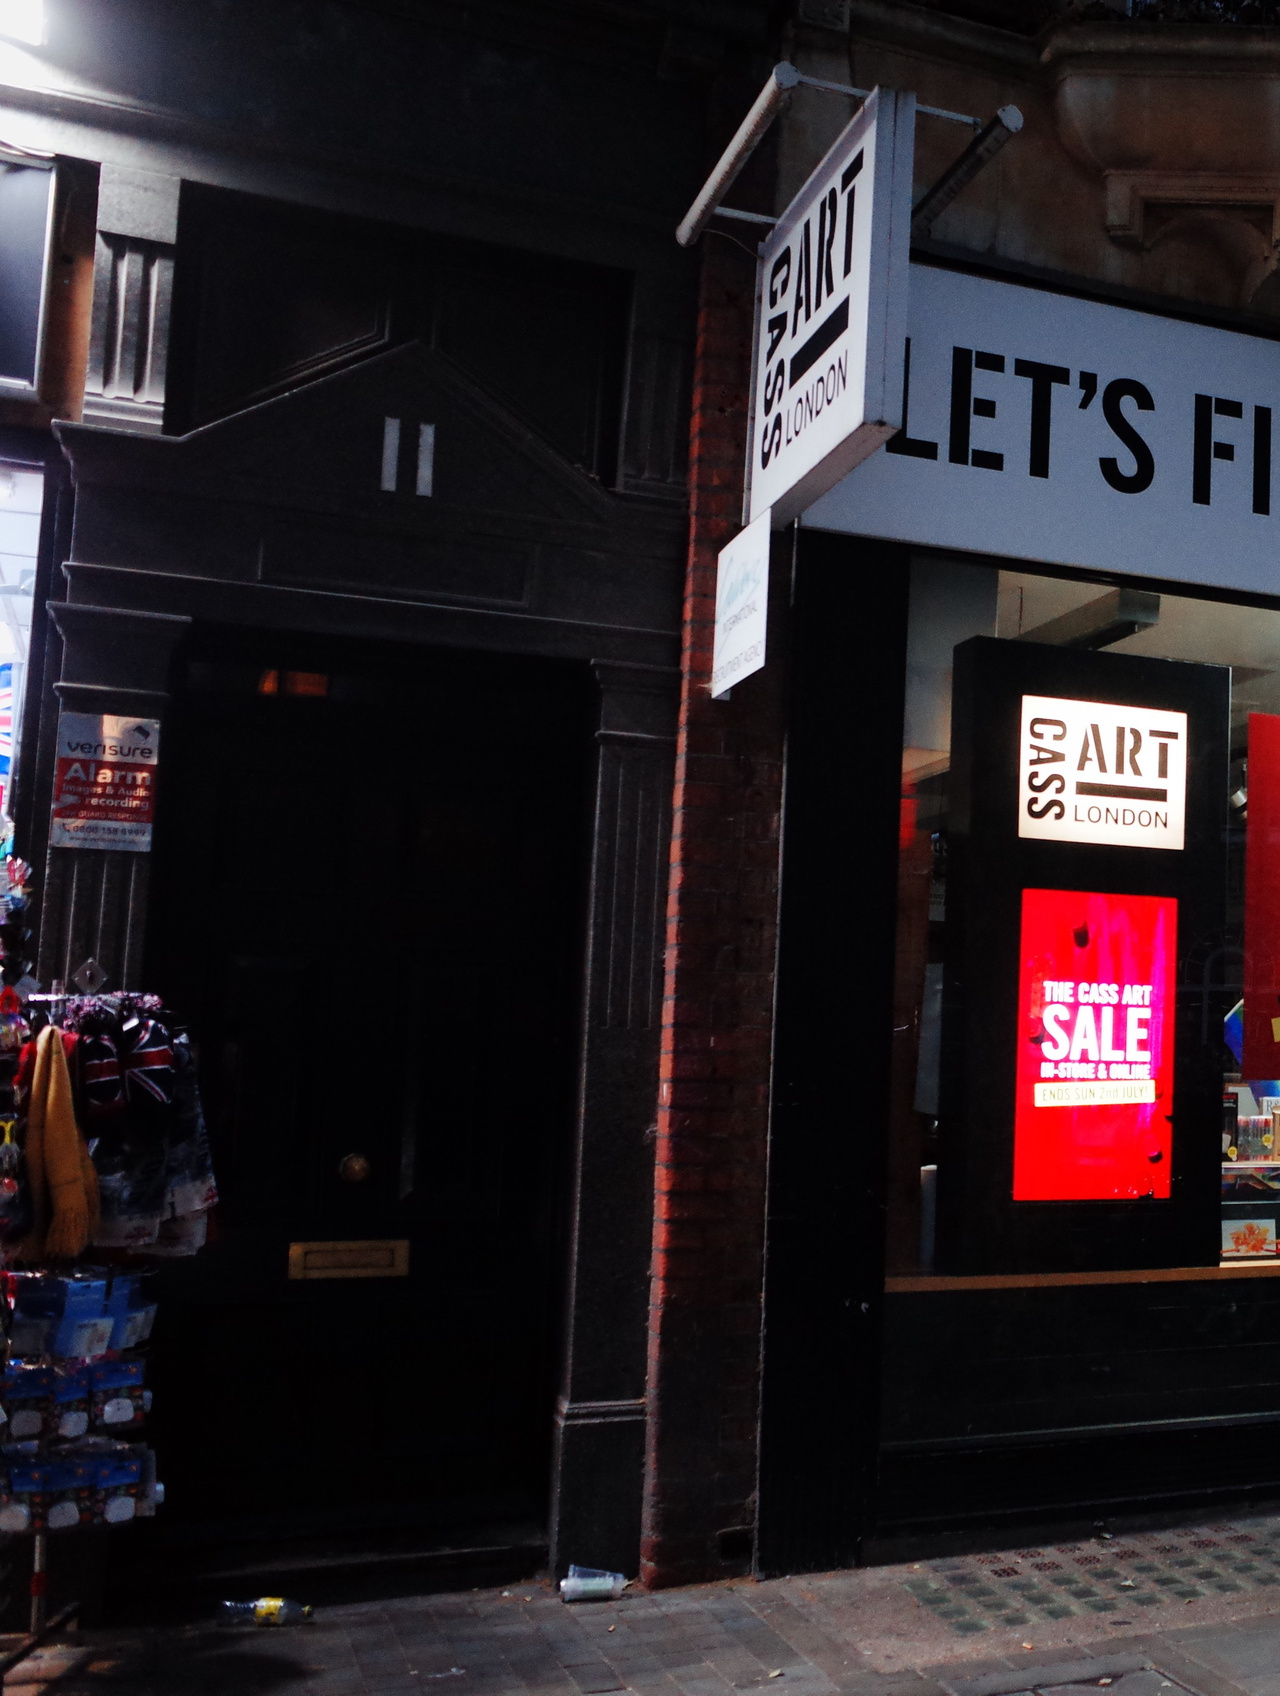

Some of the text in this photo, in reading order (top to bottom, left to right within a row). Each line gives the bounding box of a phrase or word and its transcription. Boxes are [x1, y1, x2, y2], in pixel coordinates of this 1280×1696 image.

[792, 146, 864, 339] ART
[761, 245, 791, 471] CASS
[785, 349, 848, 446] LONDON
[886, 337, 1155, 494] LET'S
[67, 741, 153, 759] verisure
[1077, 723, 1178, 779] ART
[64, 761, 151, 785] Alarm
[1027, 717, 1067, 821] CASS
[62, 783, 151, 797] Images & Audio
[84, 797, 149, 811] recording
[1074, 804, 1168, 829] LONDON
[1043, 981, 1153, 1005] THE CASS ART
[1040, 1003, 1152, 1062] SALE
[1040, 1062, 1151, 1080] IN-STORE & ONLINE
[1042, 1088, 1071, 1101] ENDS
[1075, 1087, 1095, 1101] SUN
[1100, 1086, 1119, 1099] 2nd
